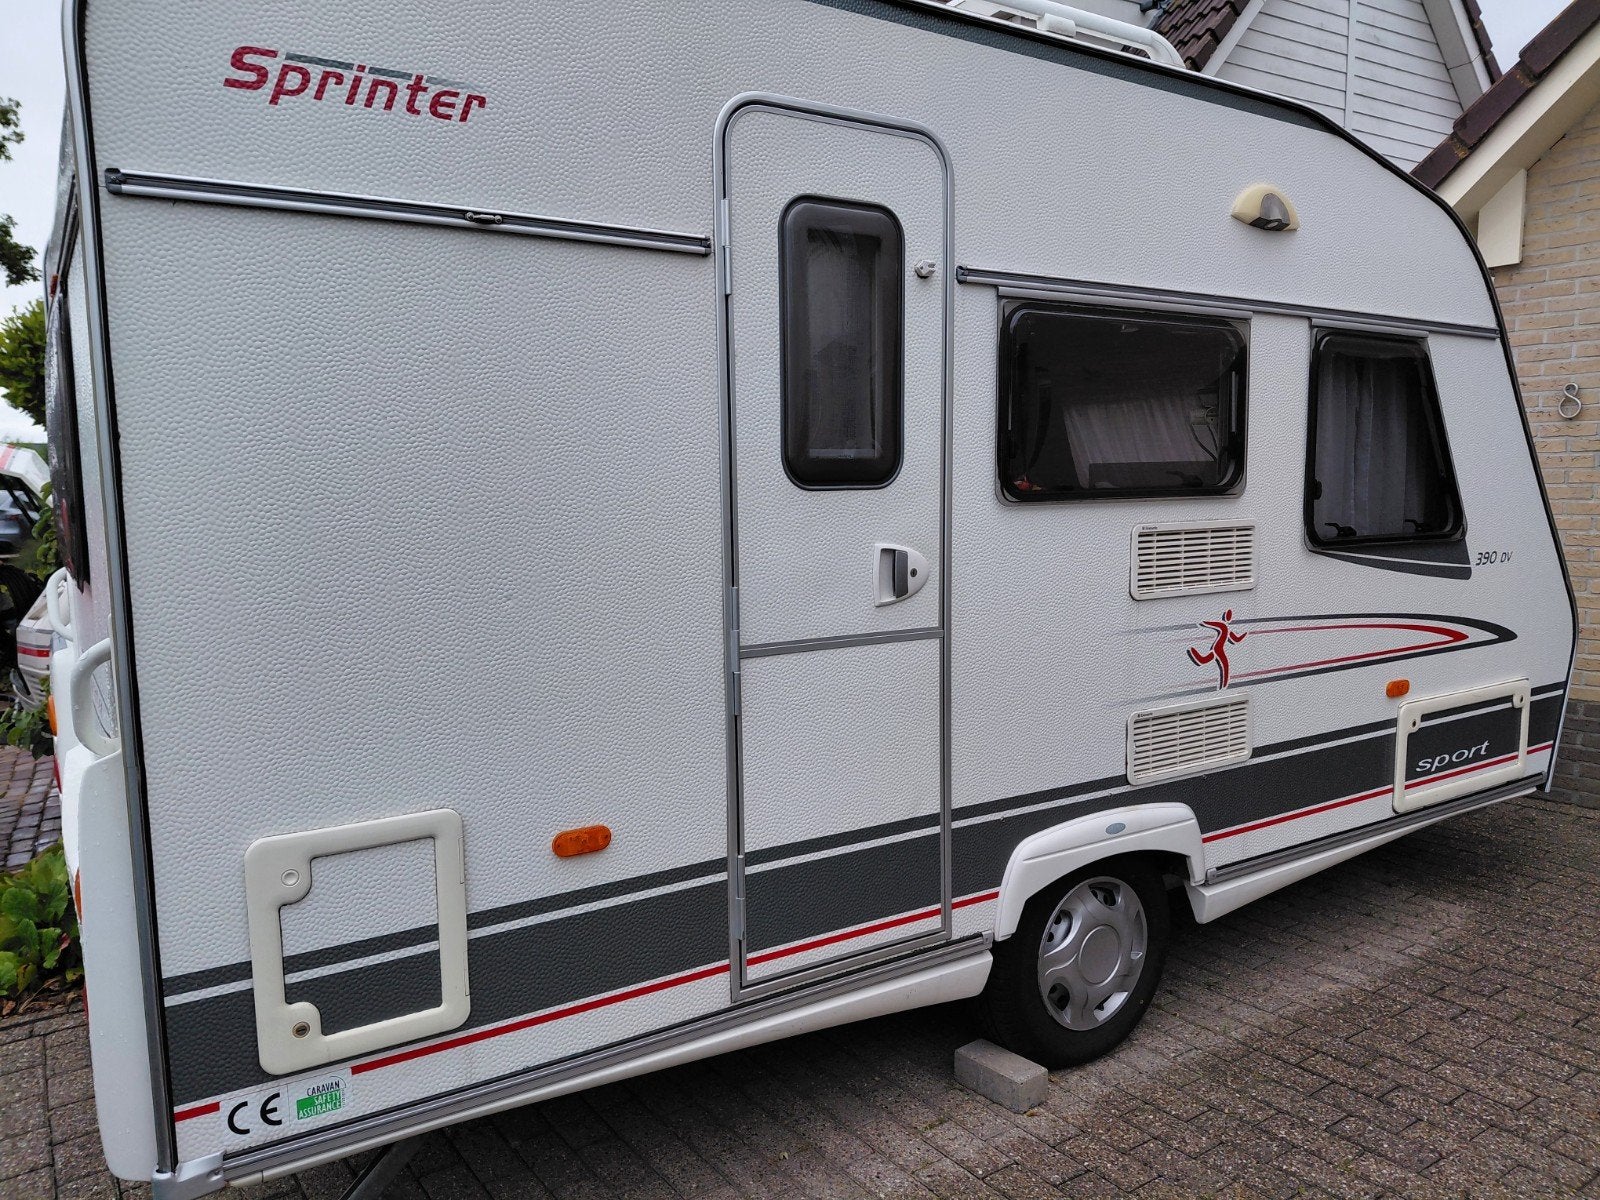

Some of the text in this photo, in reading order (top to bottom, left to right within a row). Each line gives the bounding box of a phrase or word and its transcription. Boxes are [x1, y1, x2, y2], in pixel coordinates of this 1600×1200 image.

[223, 46, 487, 122] Sprinter
[1559, 382, 1581, 418] 8
[1475, 550, 1514, 566] 390 DV
[1415, 740, 1490, 772] sport
[306, 1080, 340, 1097] CARAVAN
[314, 1090, 341, 1106] SAFETY
[227, 1092, 283, 1135] CE
[299, 1100, 341, 1119] ASSURANCE
